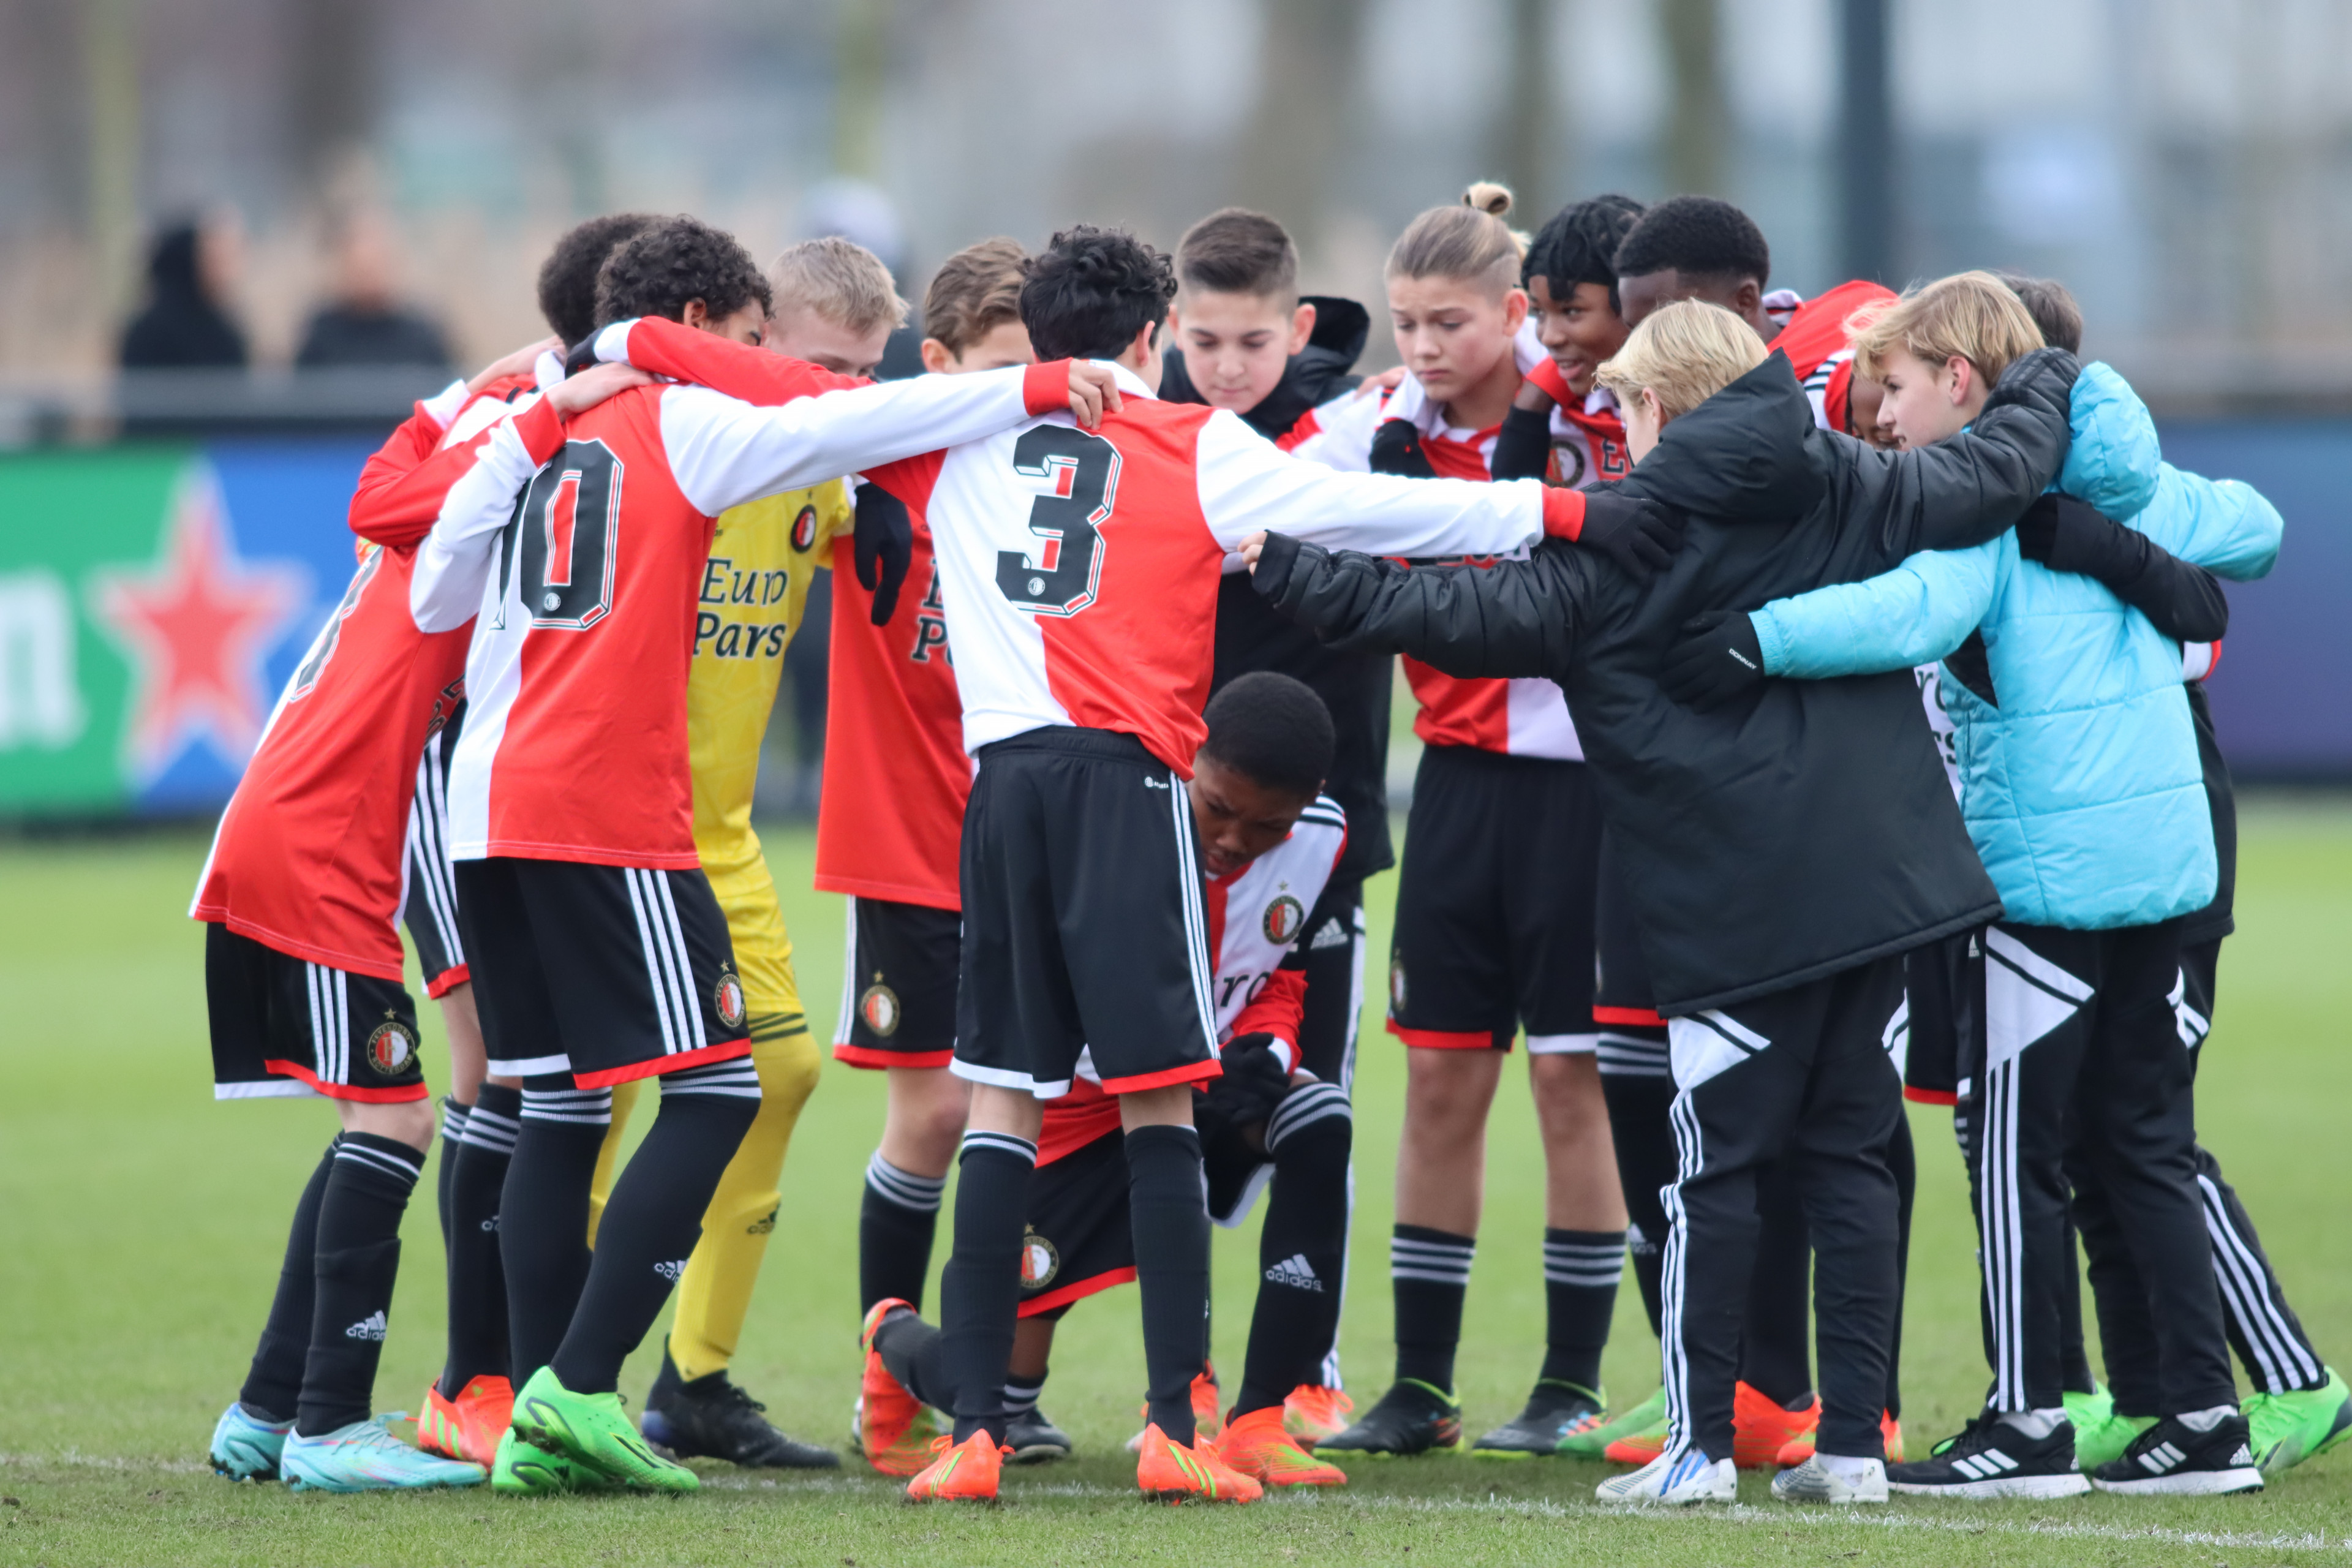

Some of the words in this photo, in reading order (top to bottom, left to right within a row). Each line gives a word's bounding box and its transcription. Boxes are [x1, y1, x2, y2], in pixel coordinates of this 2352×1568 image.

[995, 424, 1123, 618] 3
[1728, 648, 1757, 669] DONNAY
[1265, 1269, 1323, 1292] adidas
